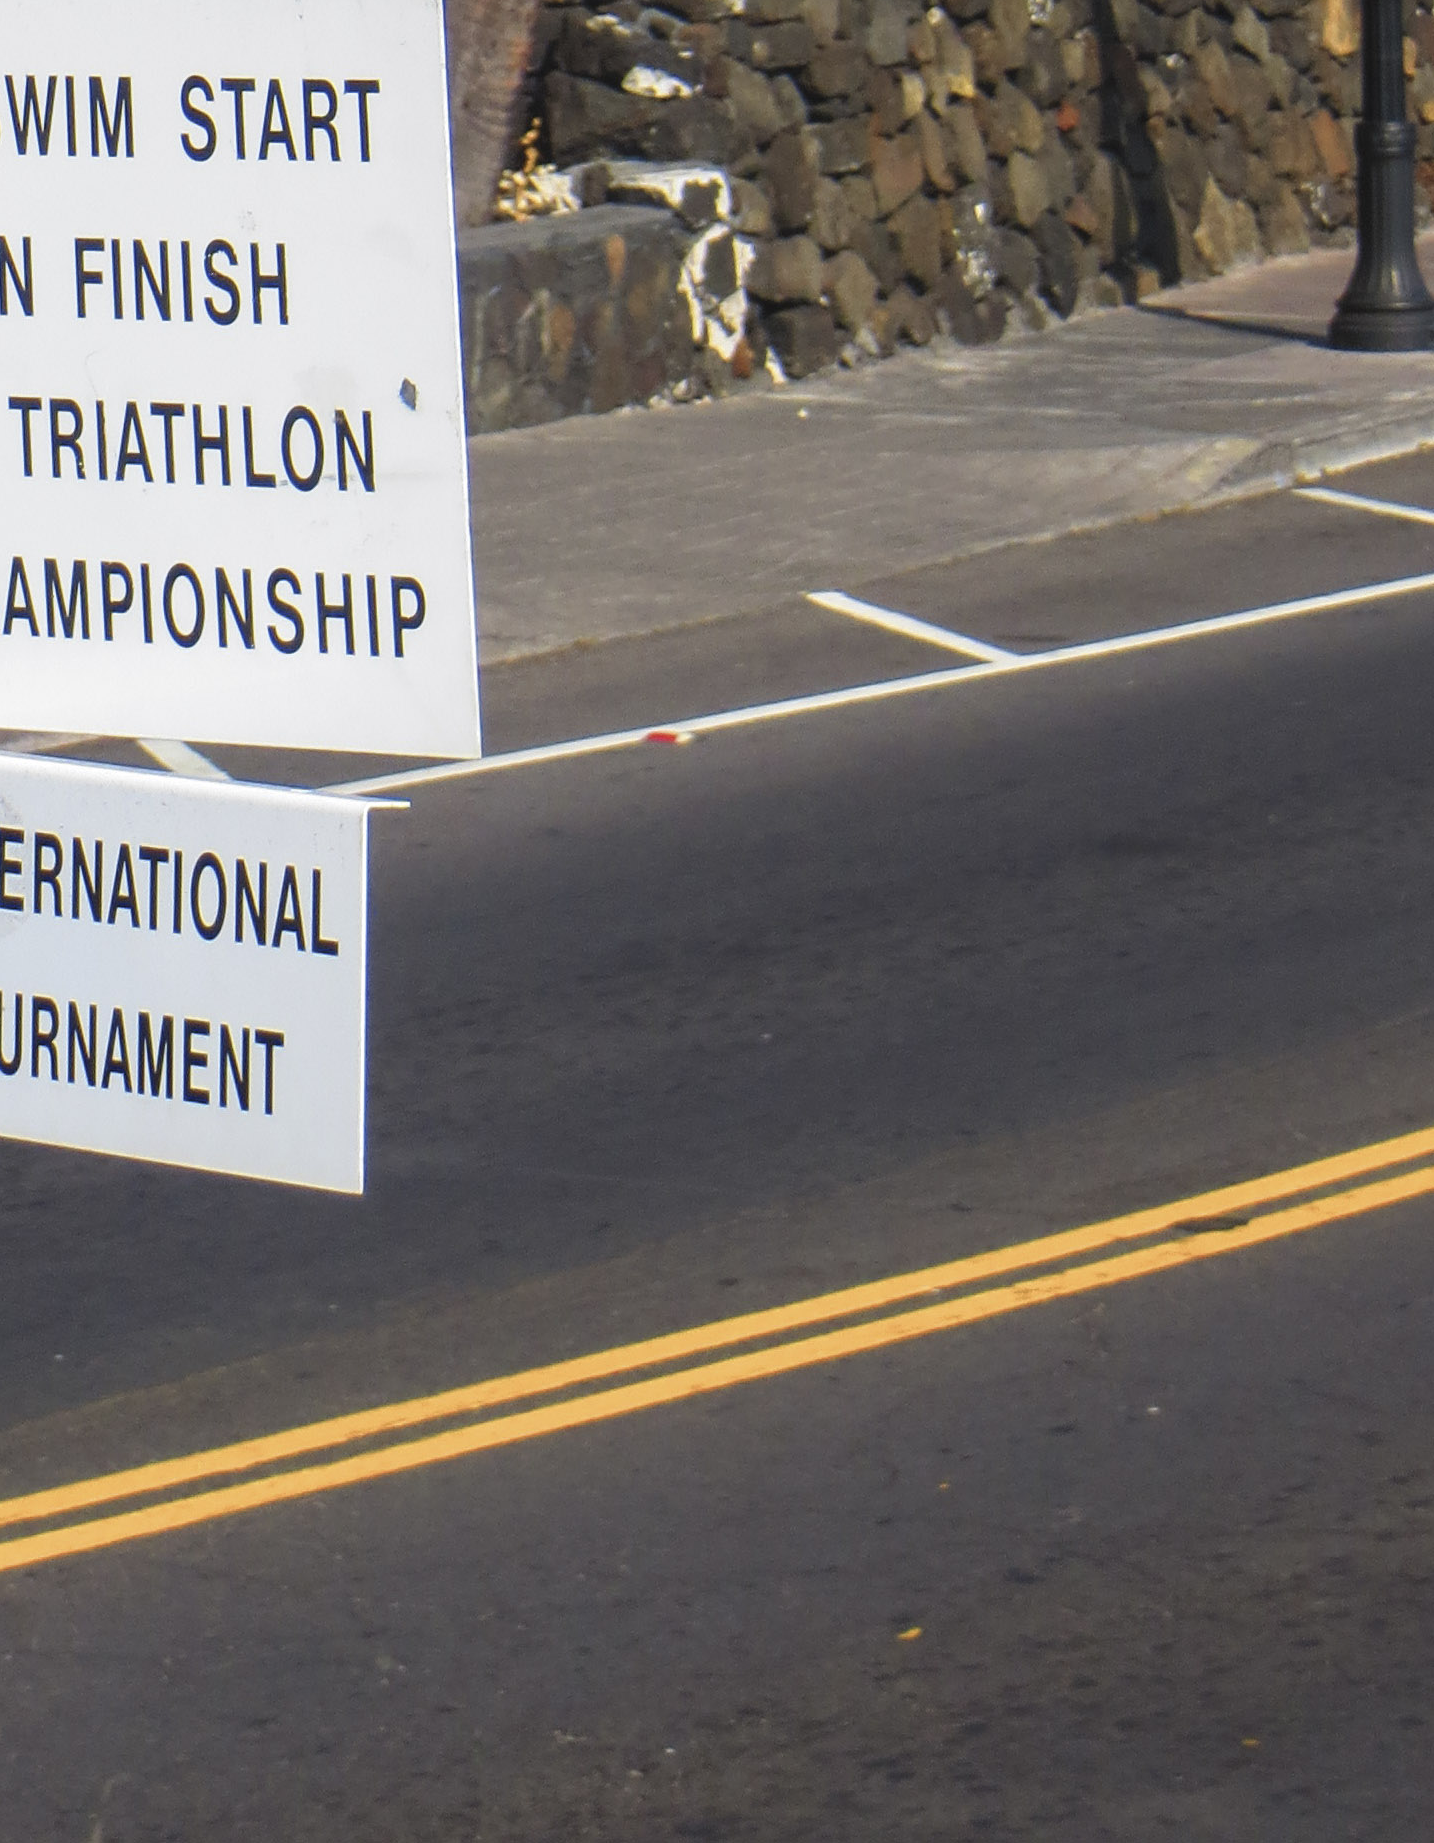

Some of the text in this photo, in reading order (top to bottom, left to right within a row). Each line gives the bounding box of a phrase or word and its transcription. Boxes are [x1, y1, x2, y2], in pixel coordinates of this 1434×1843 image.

[180, 75, 380, 163] START
[74, 238, 288, 326] FINISH
[8, 397, 375, 493] TRIATHLON
